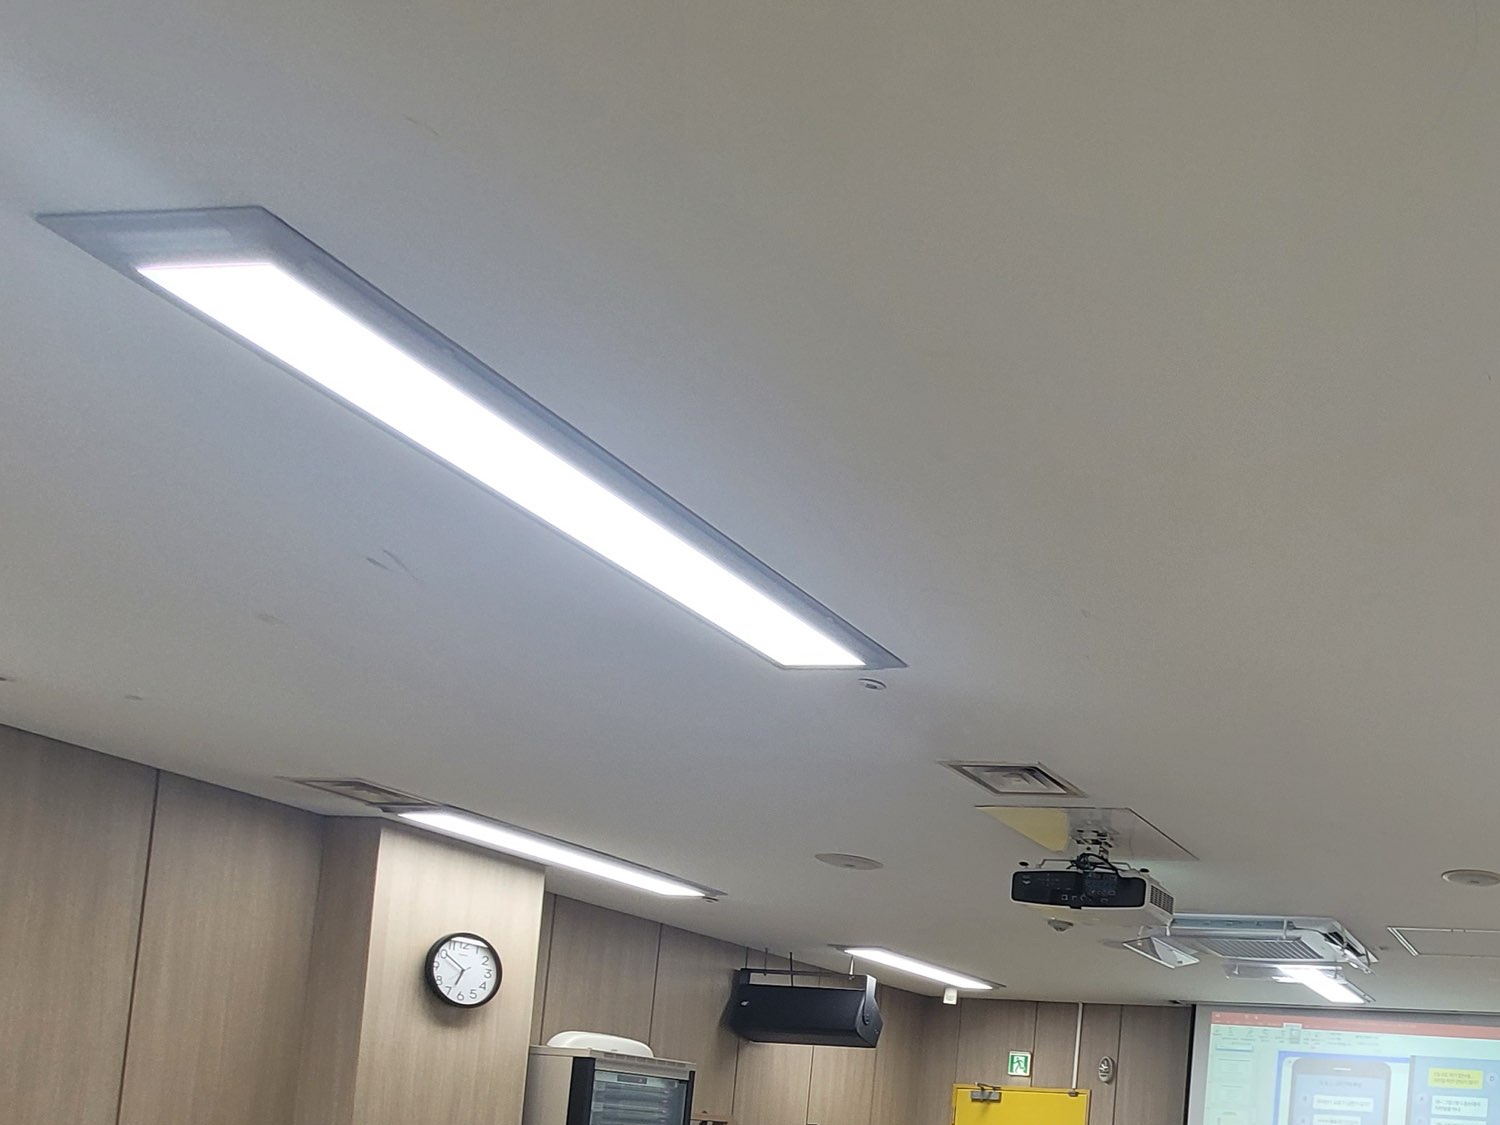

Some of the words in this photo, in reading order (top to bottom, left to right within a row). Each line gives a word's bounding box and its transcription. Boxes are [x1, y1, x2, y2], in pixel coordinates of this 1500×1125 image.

[481, 955, 490, 966] 2
[484, 968, 492, 979] 3
[436, 975, 443, 986] 8
[445, 986, 452, 995] 7
[479, 981, 487, 991] 4
[456, 991, 465, 1001] 6
[469, 989, 478, 999] 5
